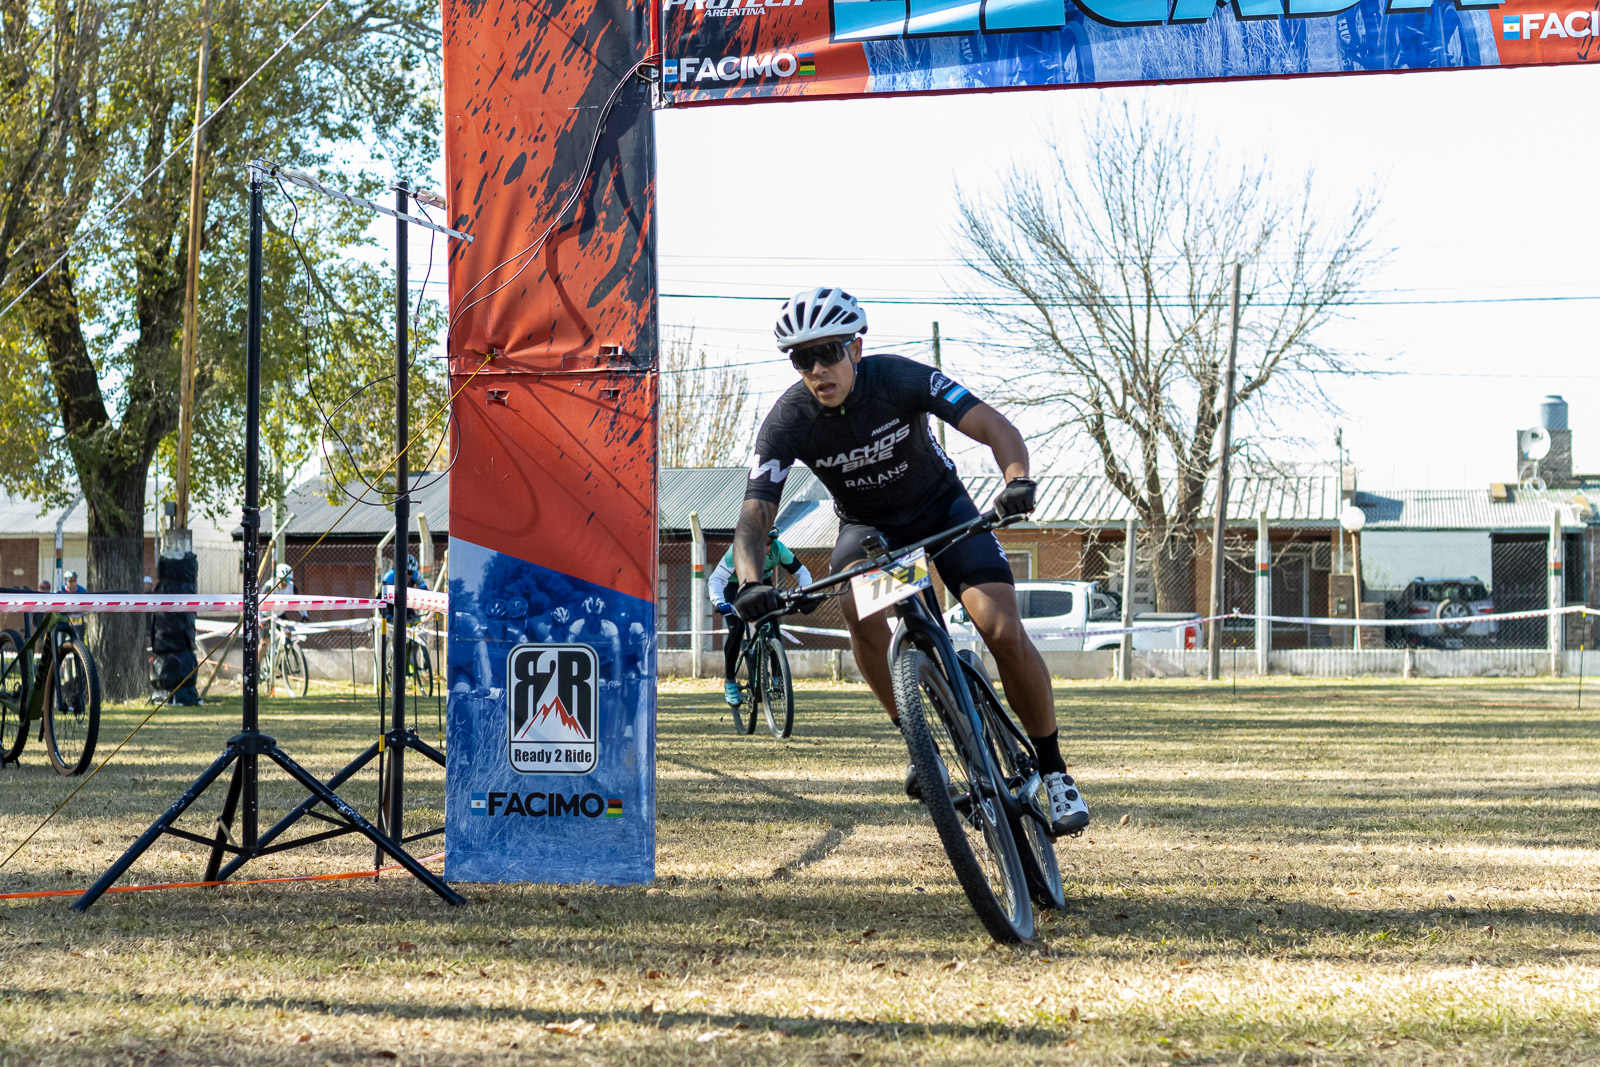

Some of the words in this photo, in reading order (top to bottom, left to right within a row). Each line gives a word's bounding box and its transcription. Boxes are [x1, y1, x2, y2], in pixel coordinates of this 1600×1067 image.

[704, 7, 766, 17] ARGENTINA
[679, 53, 797, 82] FACIMO
[815, 423, 910, 468] NACHOS
[842, 445, 894, 473] BIKE
[845, 460, 909, 488] RALANS
[514, 749, 551, 763] Ready
[554, 750, 562, 762] 2
[565, 749, 592, 763] Ride
[488, 791, 605, 818] FACIMO
